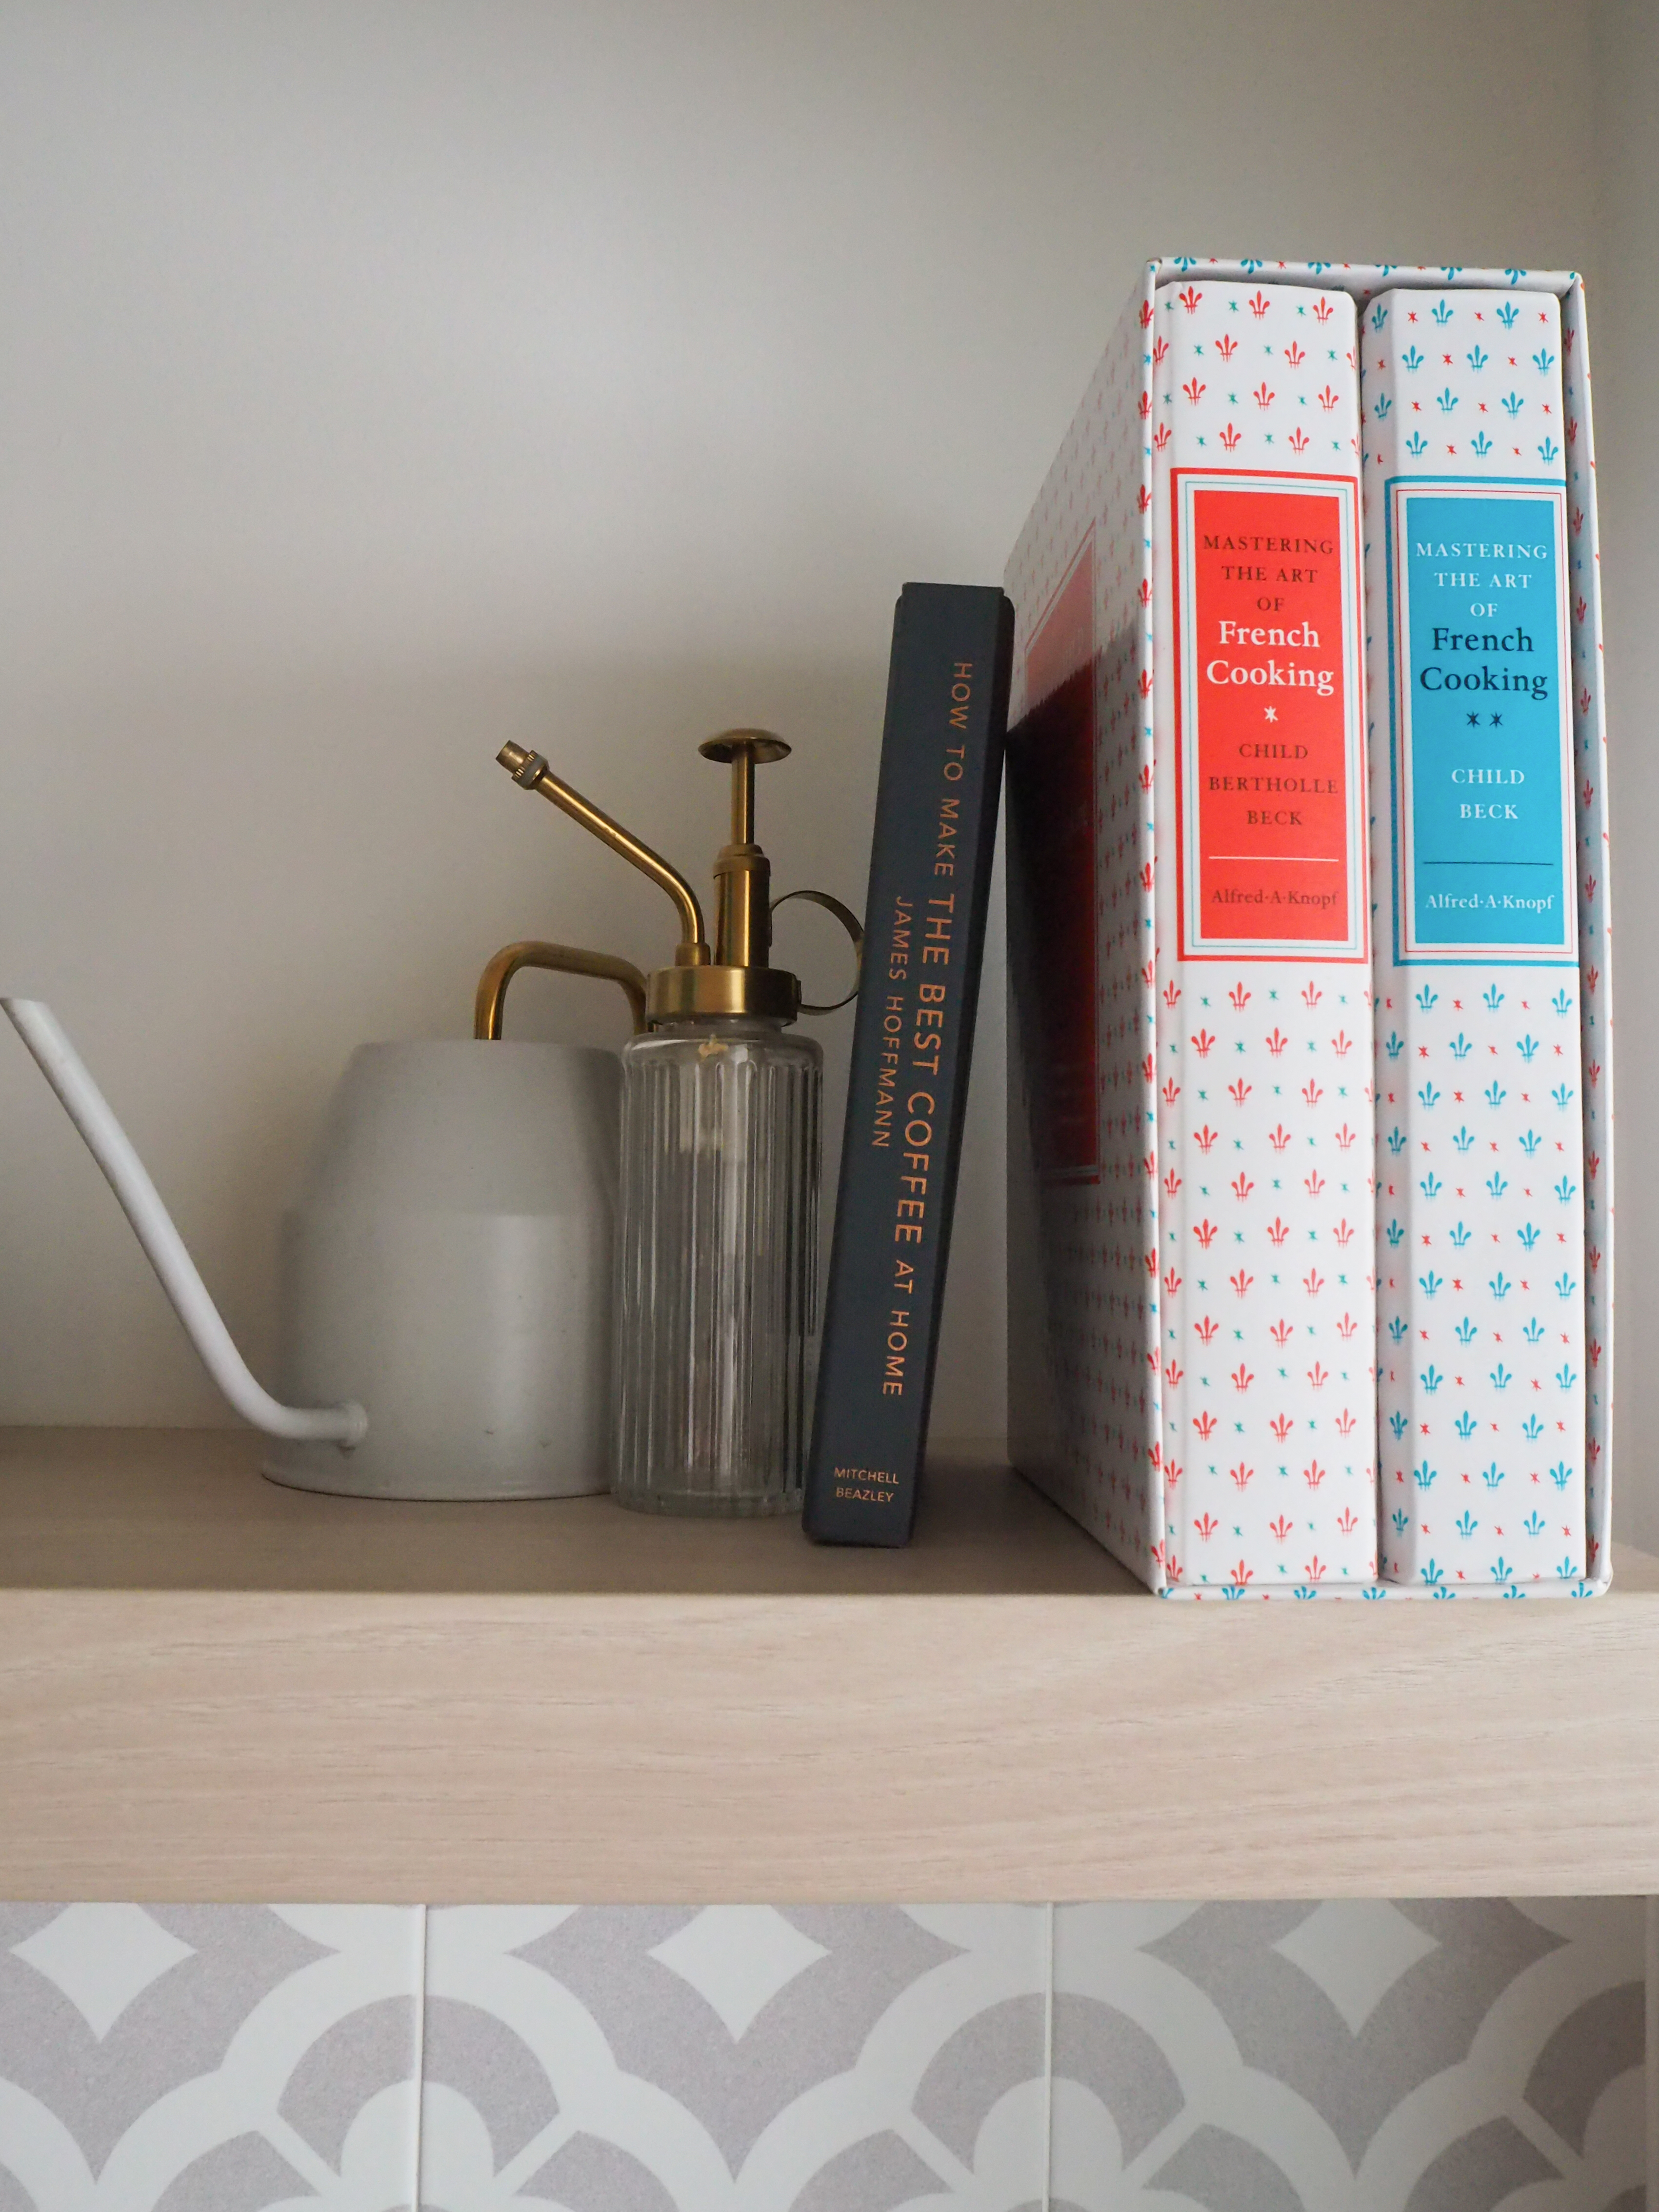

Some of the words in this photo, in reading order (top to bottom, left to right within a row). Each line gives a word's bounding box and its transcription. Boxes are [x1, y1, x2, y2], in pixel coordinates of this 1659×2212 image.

[1203, 535, 1333, 554] MASTERING
[1417, 542, 1547, 559] MASTERING
[1221, 566, 1266, 581] THE
[1276, 567, 1317, 584] ART
[1434, 573, 1480, 587] THE
[1489, 574, 1532, 588] ART
[1256, 597, 1284, 612] OF
[1470, 603, 1498, 617] OF
[1219, 621, 1320, 648] French
[1432, 627, 1534, 652] French
[1206, 659, 1334, 697] Cooking
[1419, 665, 1548, 700] Cooking
[949, 662, 973, 729] HOW
[943, 745, 965, 781] TO
[1239, 743, 1308, 759] CHILD
[1209, 776, 1338, 795] BERTHOLLE
[1451, 769, 1525, 784] CHILD
[1247, 810, 1301, 825] BECK
[1460, 804, 1518, 819] BECK
[934, 798, 960, 876] MAKE
[889, 896, 913, 980] JAMES
[922, 893, 955, 965] THE
[913, 984, 946, 1076] BEST
[872, 996, 904, 1147] HOFFMANN
[894, 1091, 935, 1243] COFFEE
[894, 1259, 914, 1294] AT
[883, 1310, 910, 1395] HOME
[834, 1467, 899, 1484] MITCHELL
[836, 1487, 894, 1502] BEAZLEY
